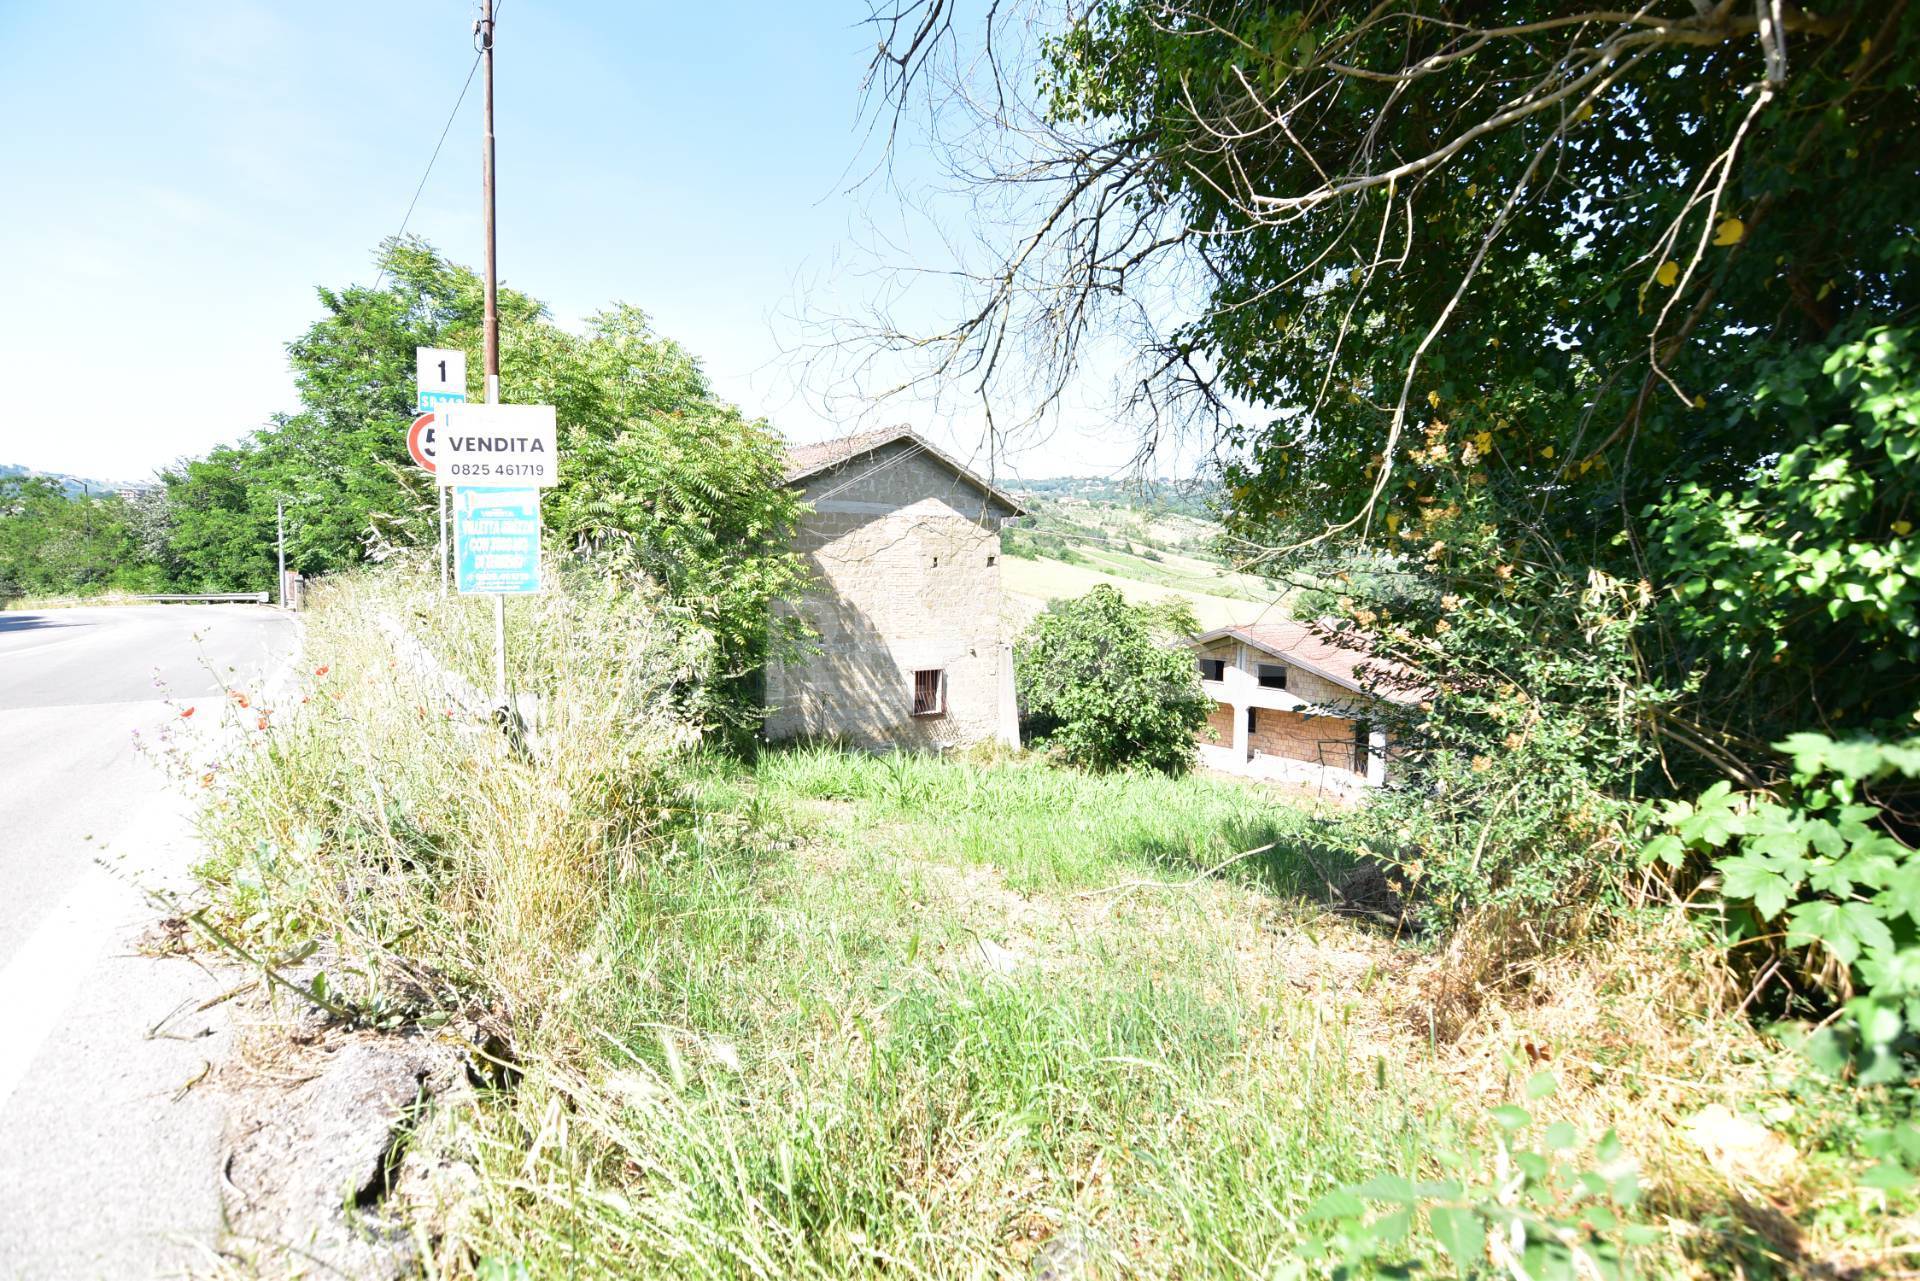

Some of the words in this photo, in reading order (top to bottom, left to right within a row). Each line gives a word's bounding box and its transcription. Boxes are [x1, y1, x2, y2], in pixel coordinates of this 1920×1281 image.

[438, 360, 446, 382] 1
[448, 437, 545, 453] VENDITA
[451, 463, 490, 476] 0825
[495, 463, 544, 476] 461719
